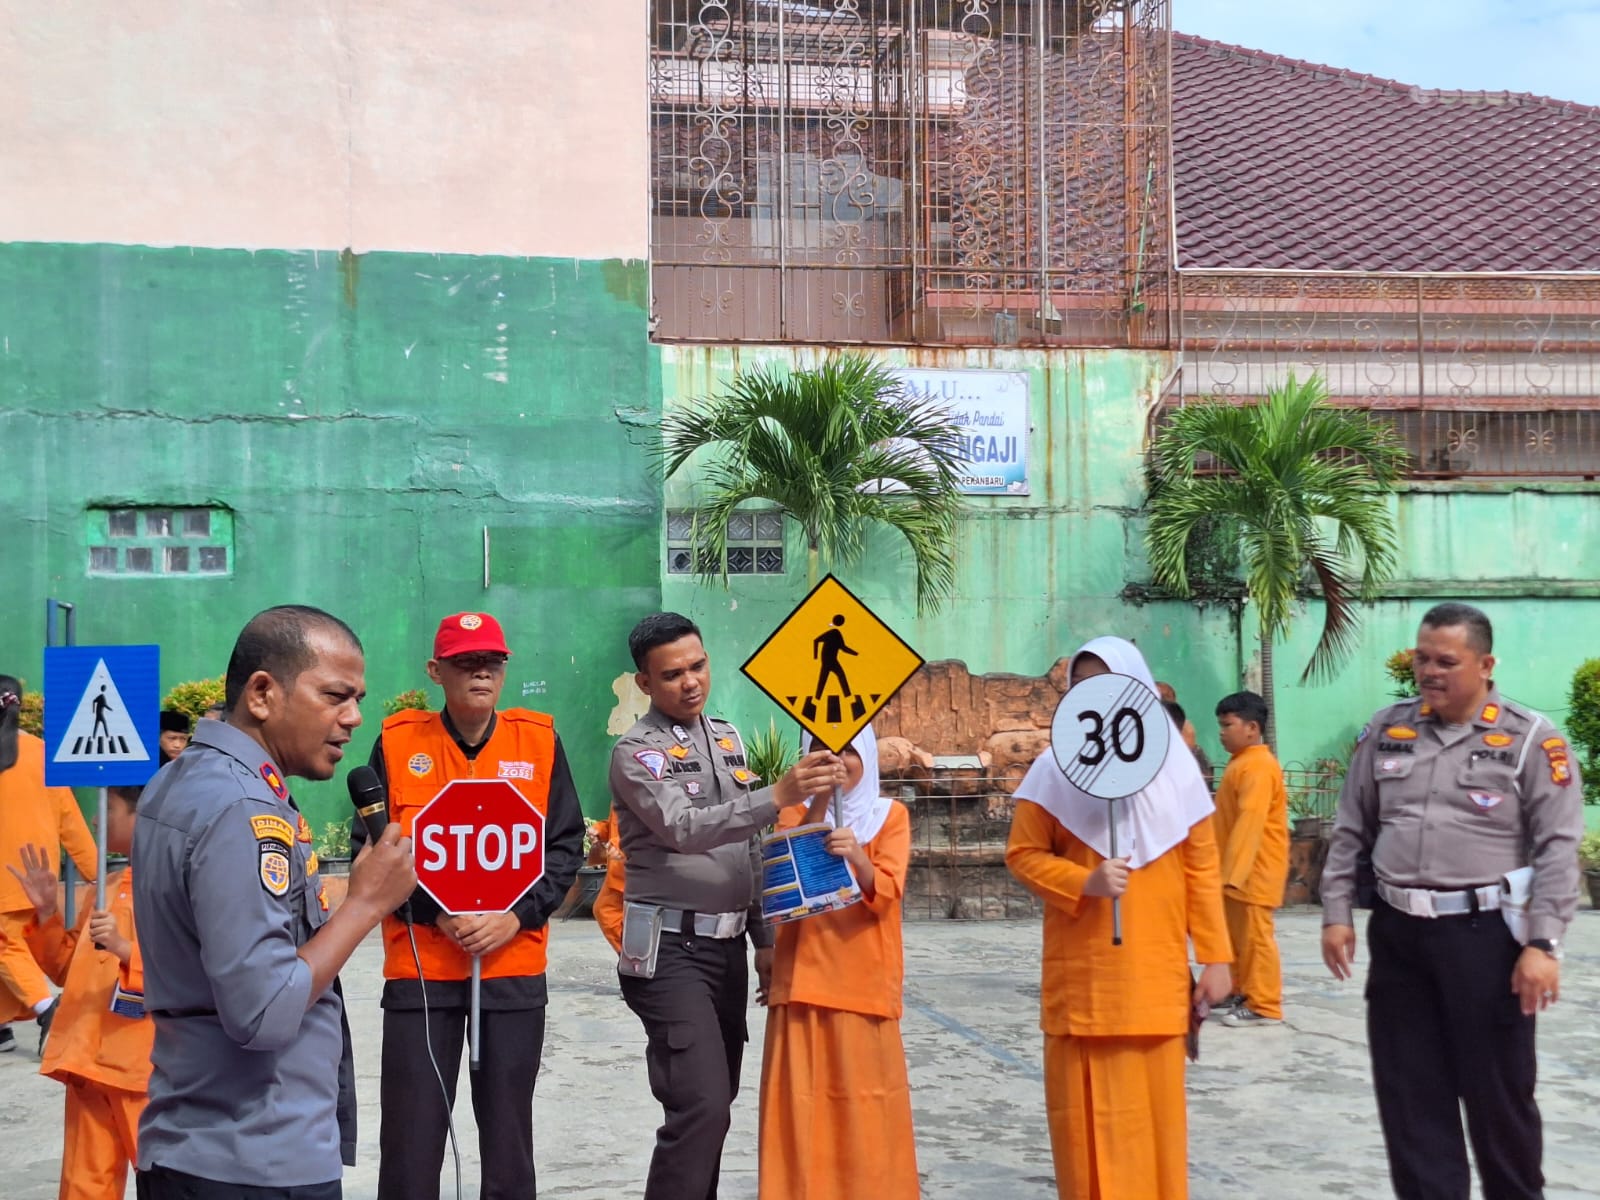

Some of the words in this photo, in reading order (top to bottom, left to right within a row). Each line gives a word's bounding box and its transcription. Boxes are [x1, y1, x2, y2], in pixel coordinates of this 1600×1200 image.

[972, 410, 1005, 426] Pandai
[1077, 707, 1145, 766] 30
[422, 823, 537, 872] STOP
